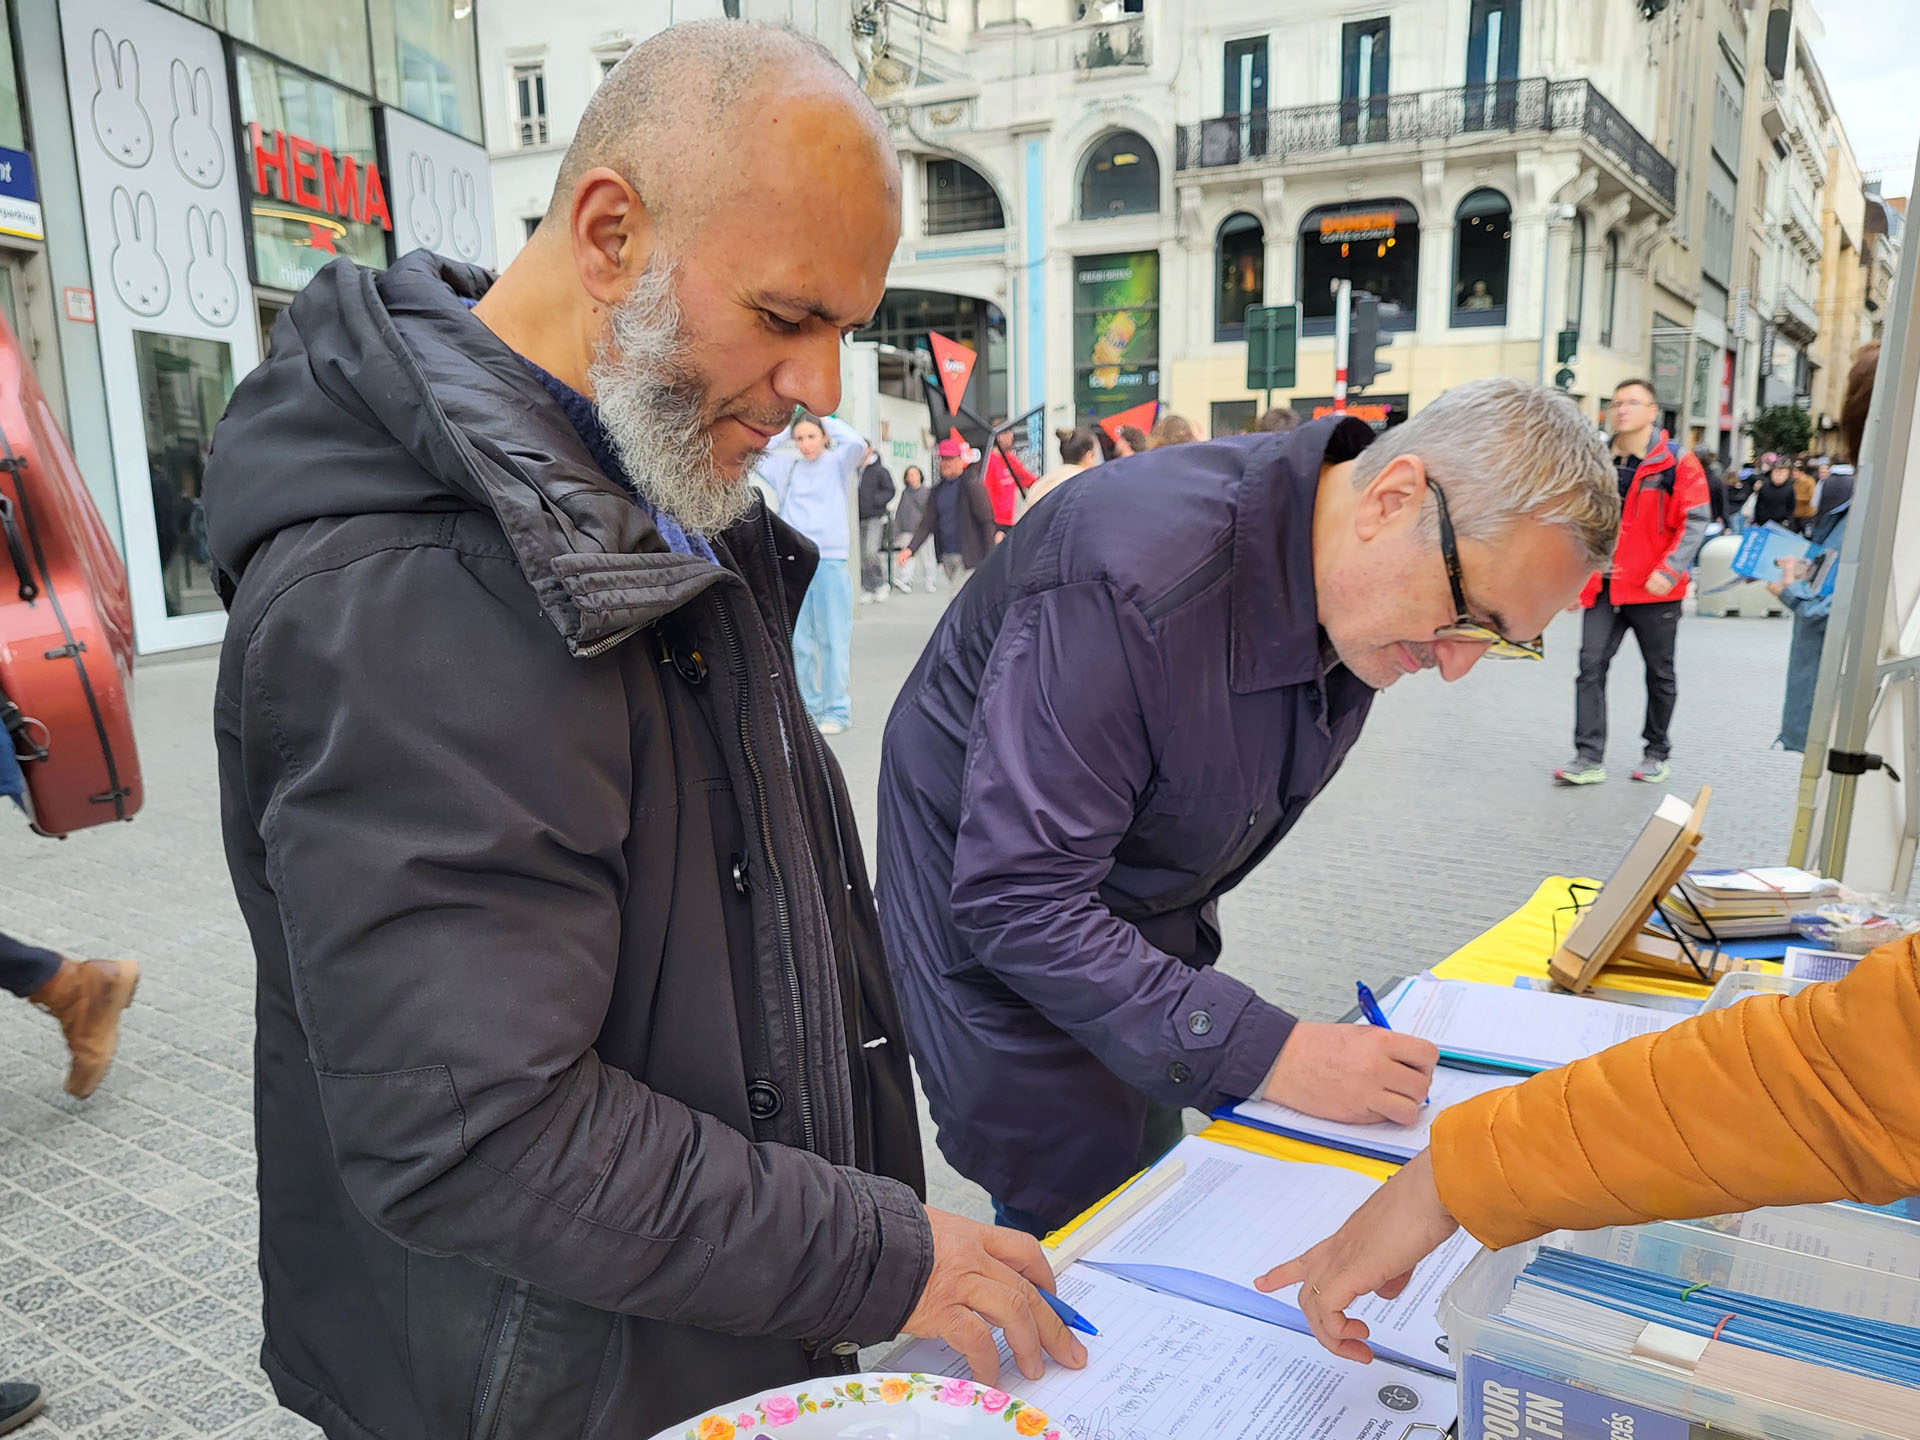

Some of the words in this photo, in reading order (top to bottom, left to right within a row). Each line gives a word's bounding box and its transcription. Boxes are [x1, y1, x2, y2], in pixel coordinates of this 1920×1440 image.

[251, 121, 393, 232] HEMA
[1525, 1392, 1564, 1439] FIN
[1601, 1412, 1634, 1440] cés
